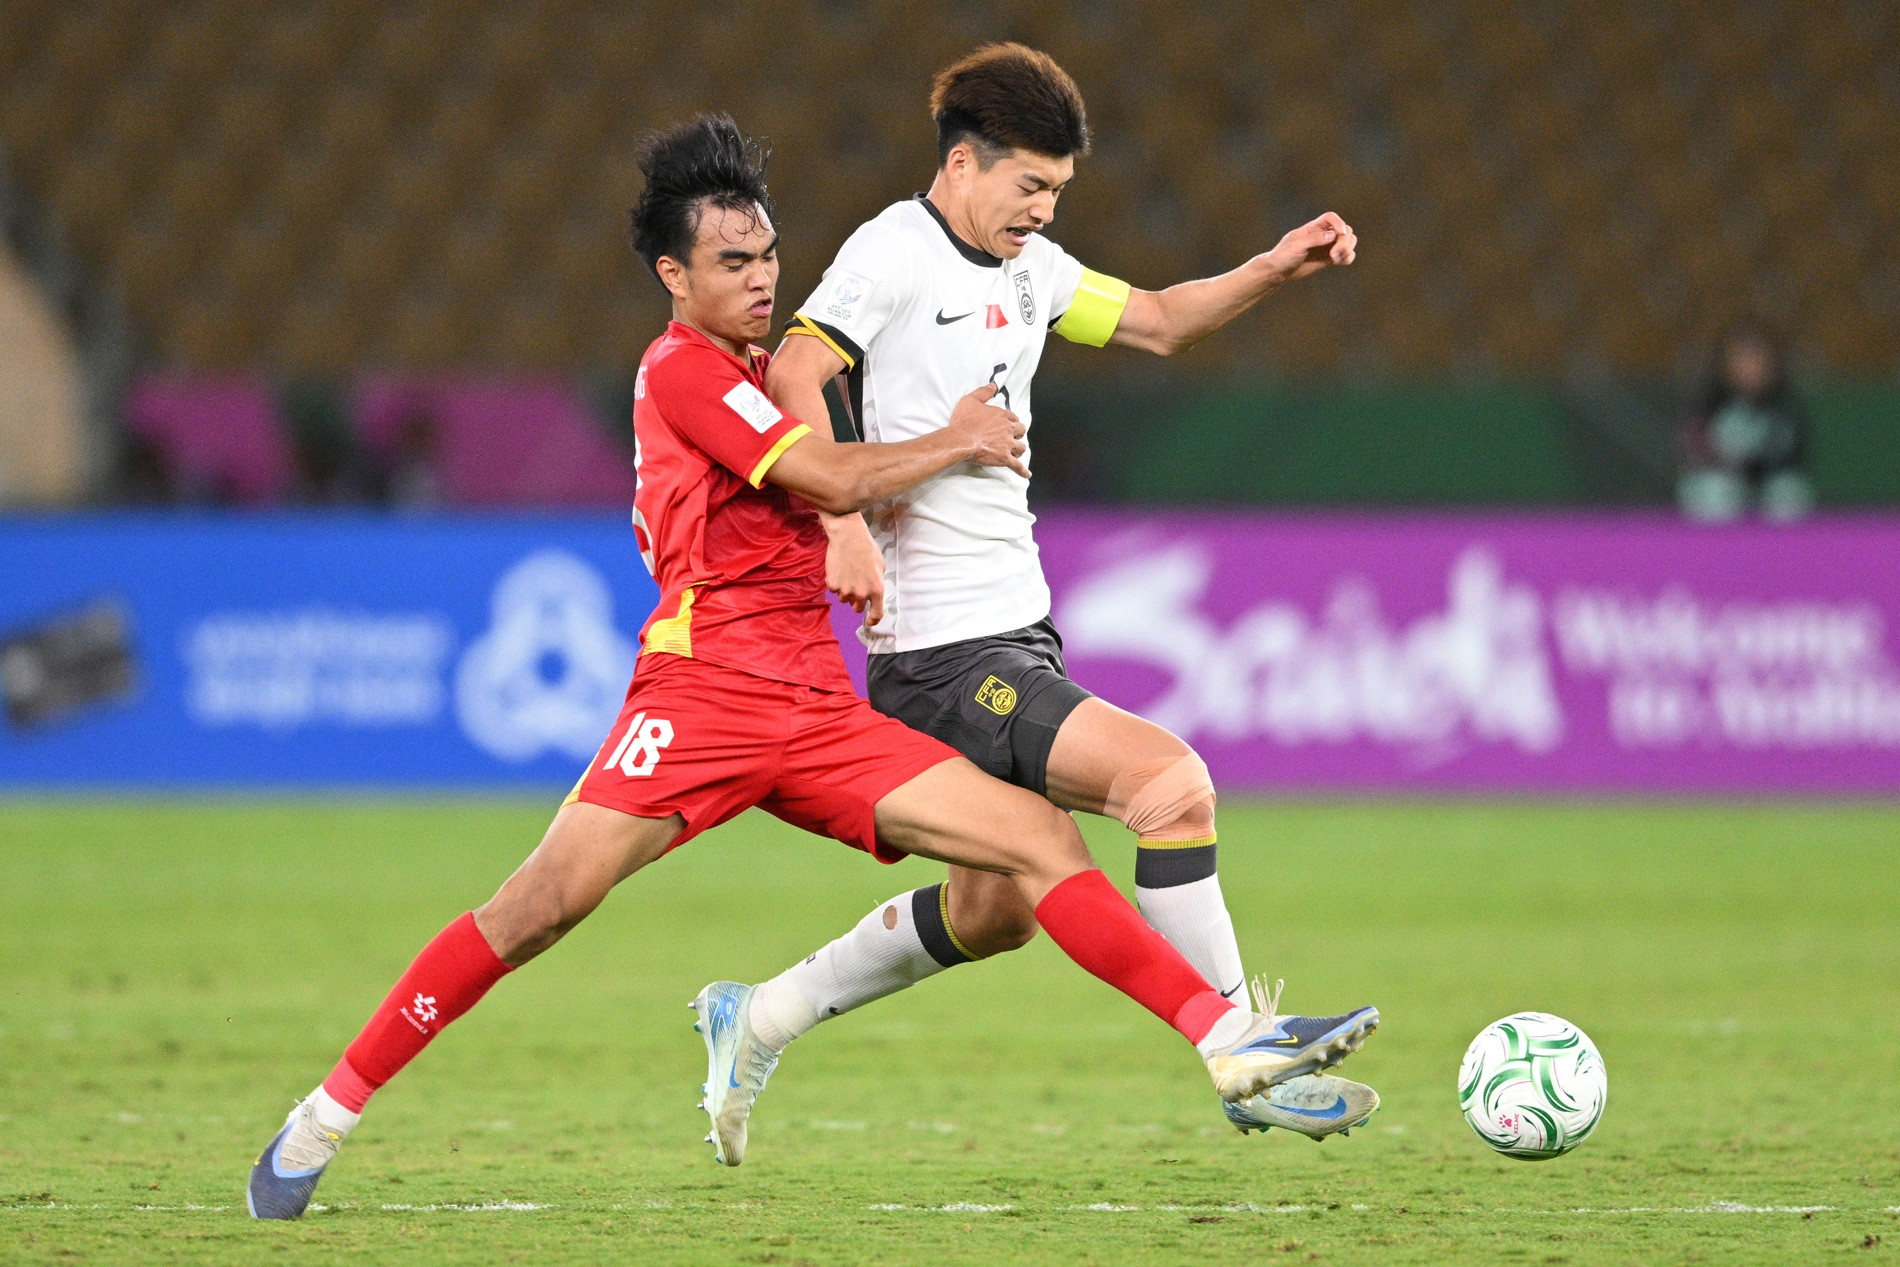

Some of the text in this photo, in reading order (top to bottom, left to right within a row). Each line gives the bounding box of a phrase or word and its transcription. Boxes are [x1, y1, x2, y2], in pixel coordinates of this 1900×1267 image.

[1015, 274, 1029, 286] CFA
[978, 678, 997, 701] CFA
[602, 711, 675, 777] 18
